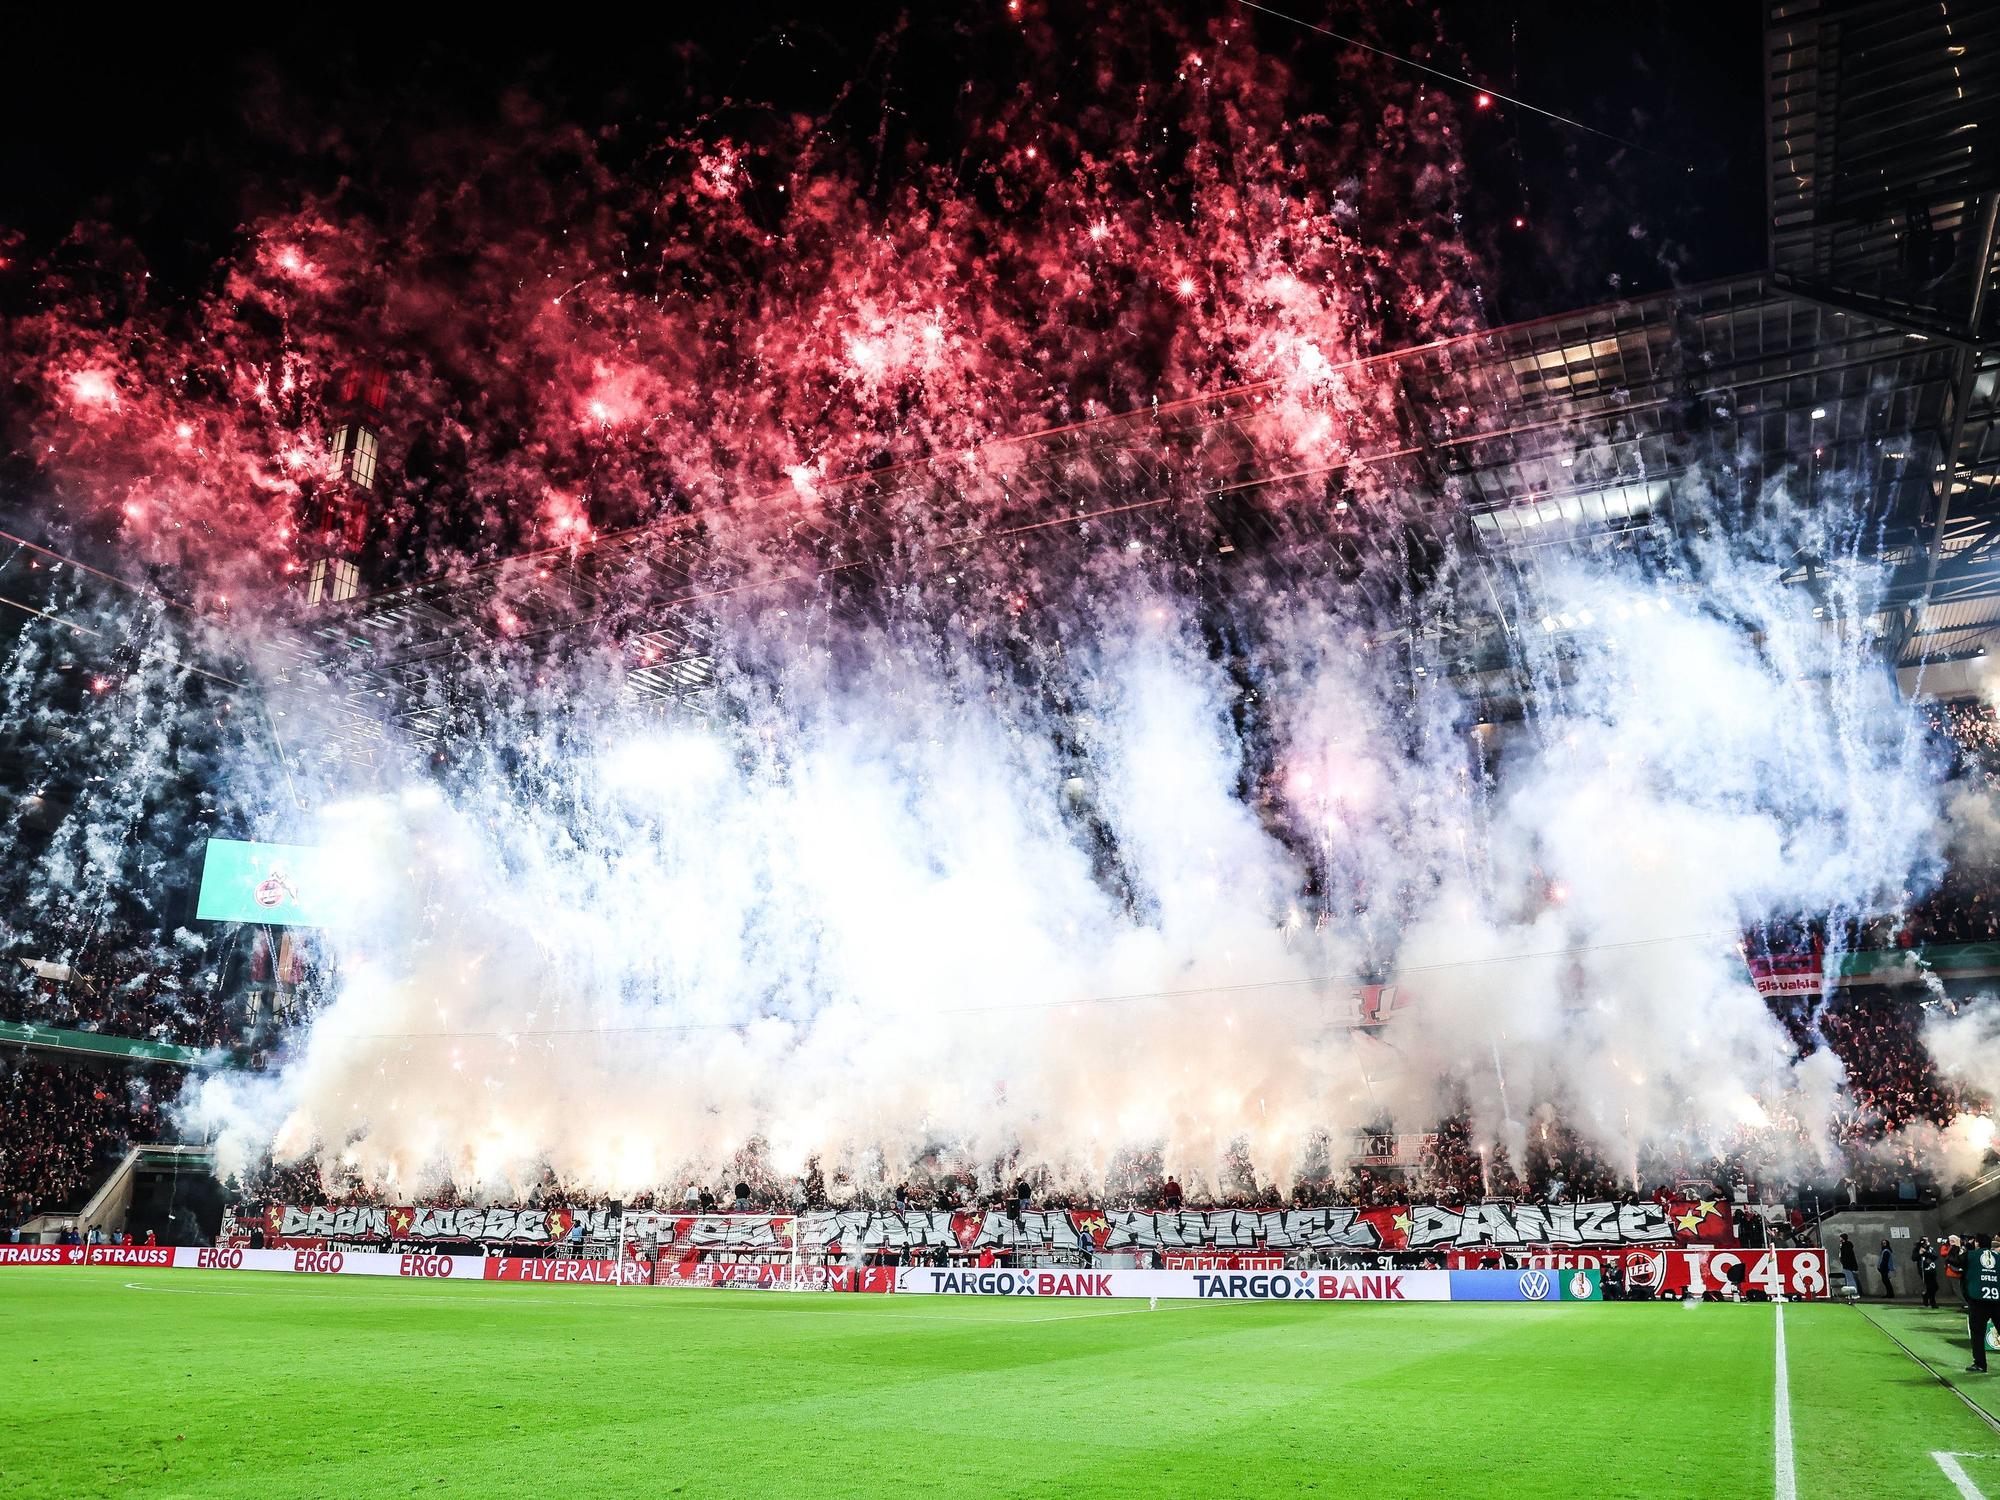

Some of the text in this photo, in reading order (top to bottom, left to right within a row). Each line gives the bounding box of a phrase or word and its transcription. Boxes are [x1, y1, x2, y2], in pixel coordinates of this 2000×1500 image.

[1757, 979, 1819, 993] Slovakia
[1409, 1203, 1675, 1247] DANZE
[0, 1248, 61, 1262] TRAUSS
[93, 1249, 168, 1263] STRAUSS
[199, 1249, 243, 1269] ERGO
[294, 1251, 344, 1273] ERGO
[400, 1254, 454, 1278] ERGO
[520, 1259, 652, 1285] FLYERALARM
[1684, 1252, 1824, 1295] 1948
[773, 1281, 798, 1290] ERG
[1981, 1286, 2000, 1300] 29
